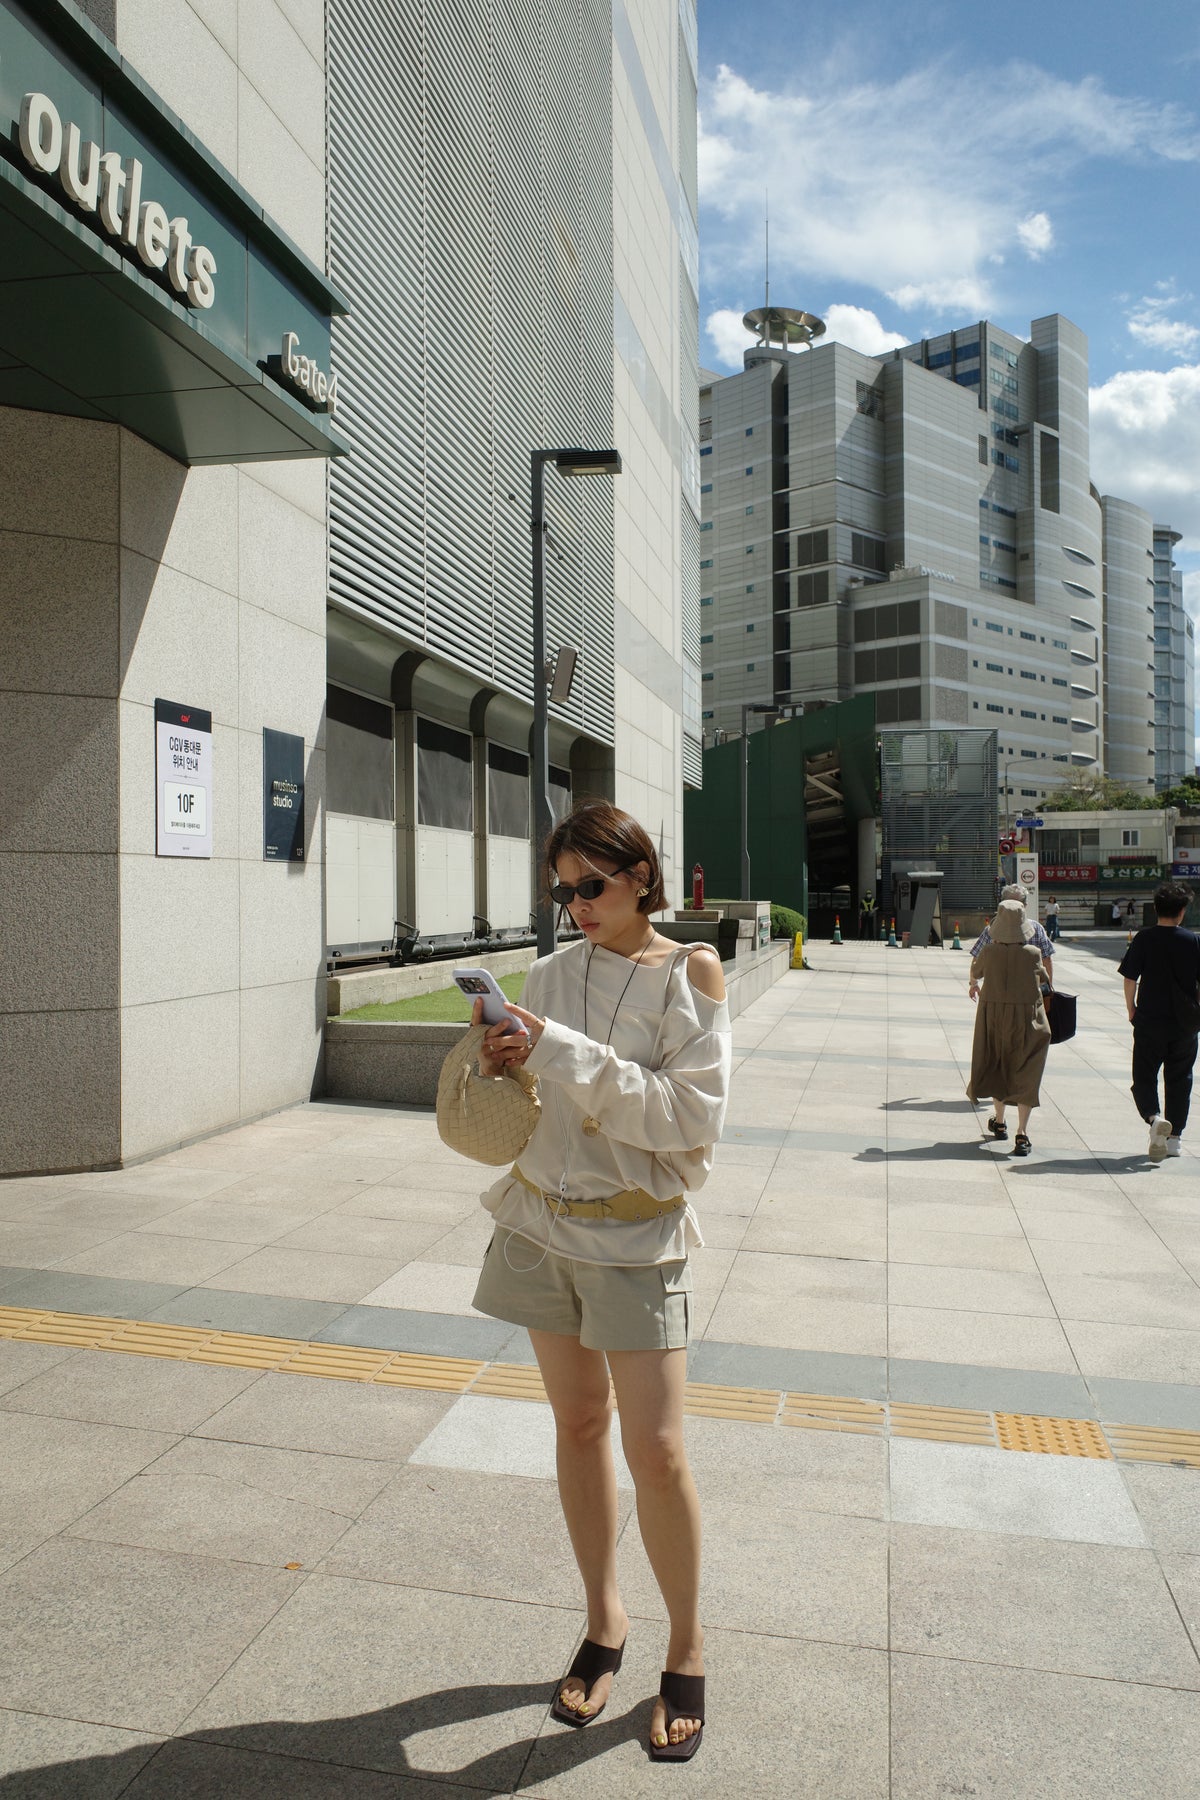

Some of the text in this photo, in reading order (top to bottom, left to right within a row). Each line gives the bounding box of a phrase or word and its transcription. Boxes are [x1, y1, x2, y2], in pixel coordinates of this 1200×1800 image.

[169, 736, 202, 755] CGV동대문
[173, 754, 199, 772] 위치 안내
[273, 780, 297, 793] musinsa
[177, 793, 195, 813] 10F
[273, 795, 292, 808] studio
